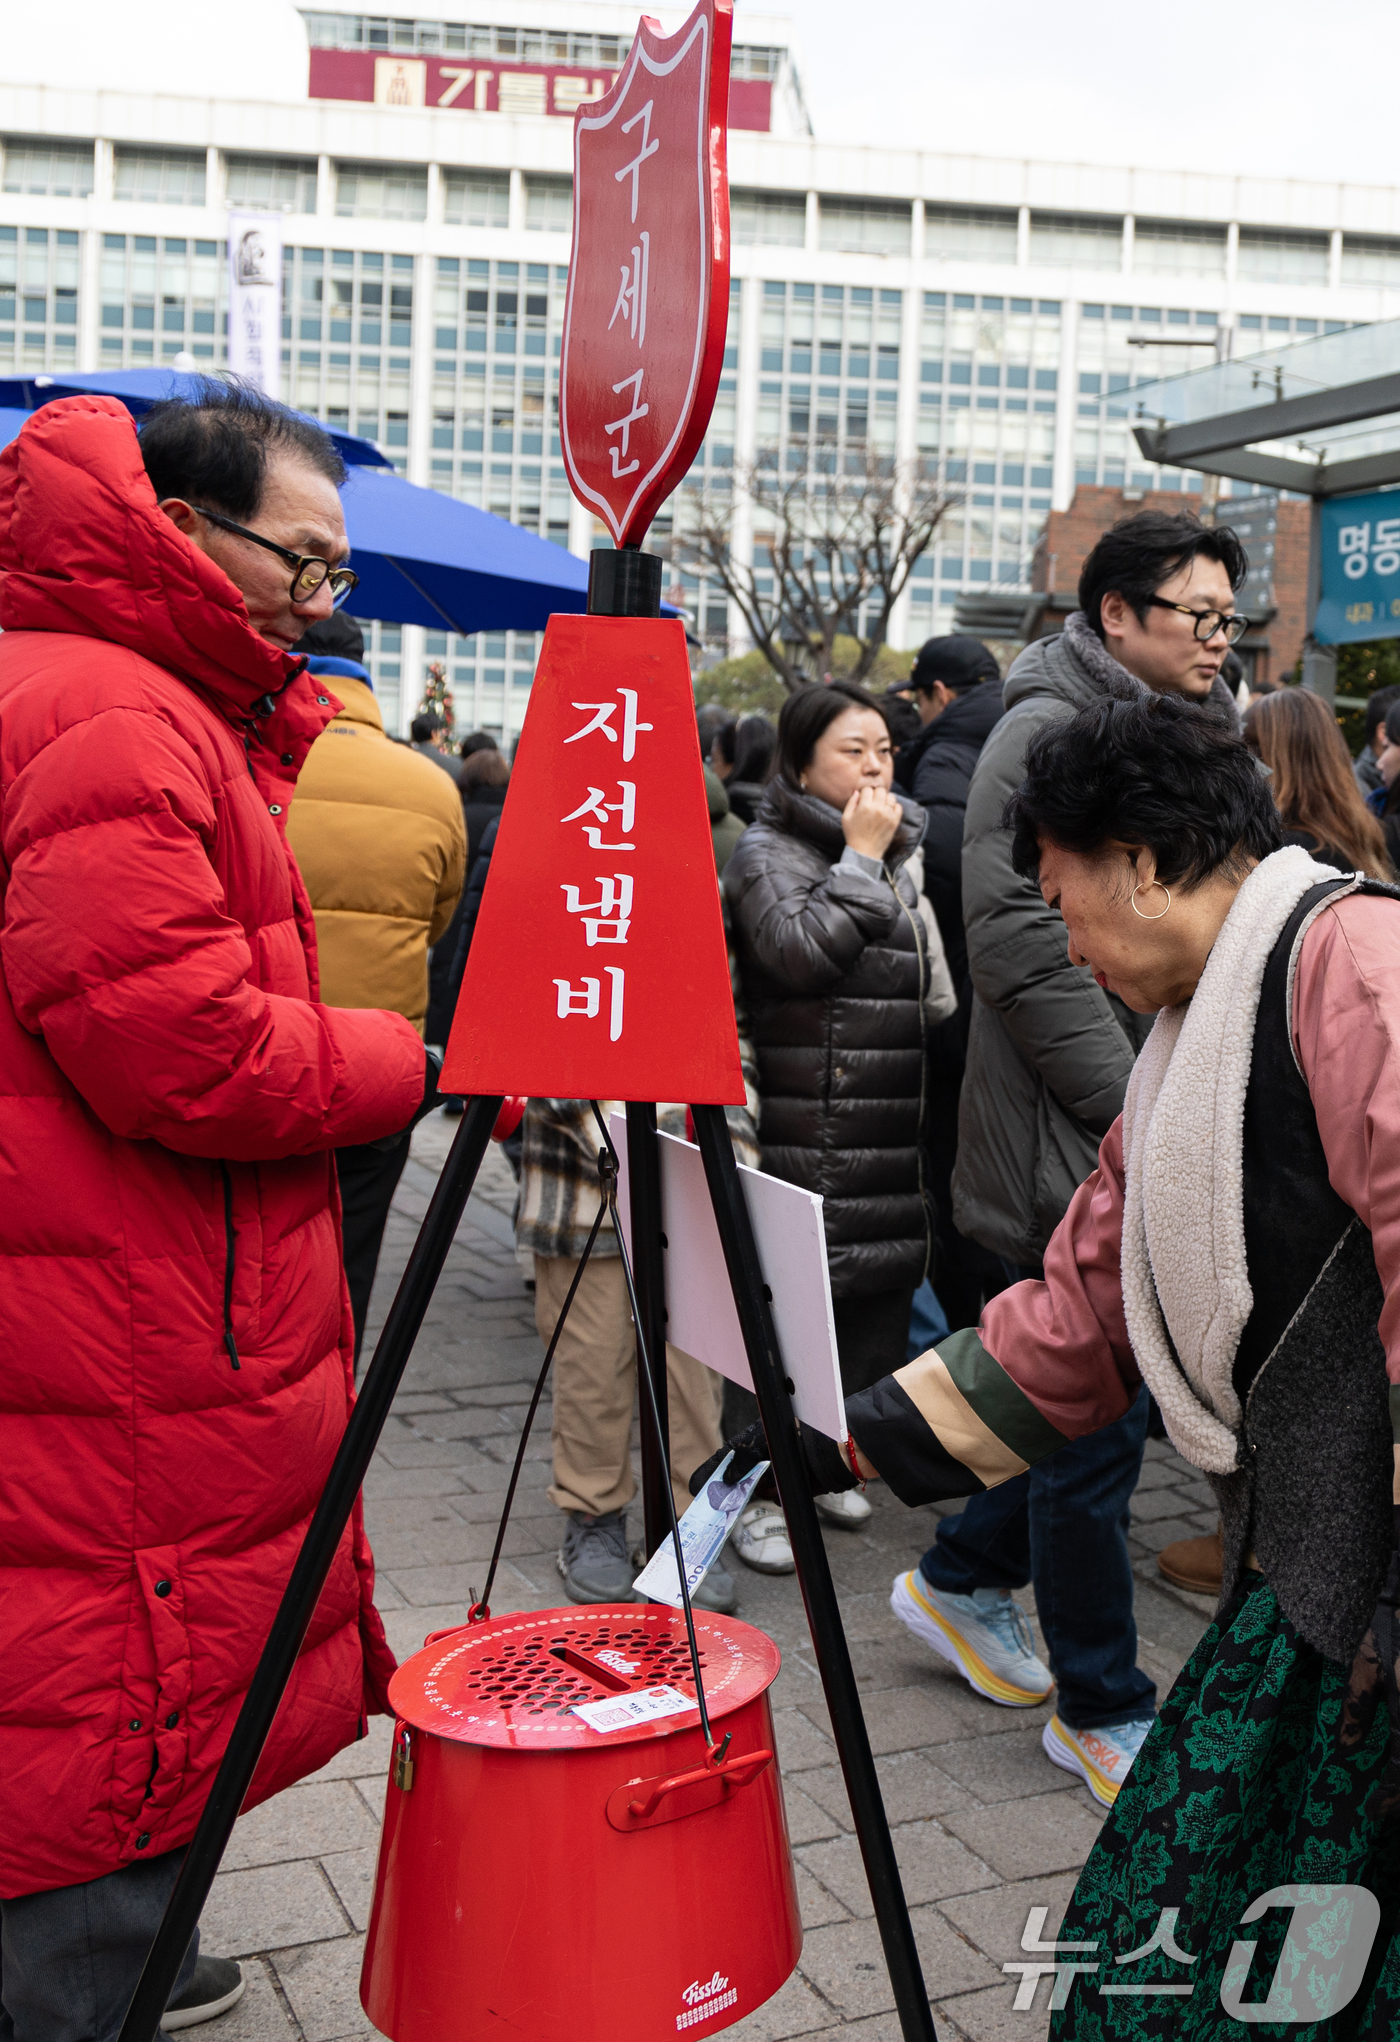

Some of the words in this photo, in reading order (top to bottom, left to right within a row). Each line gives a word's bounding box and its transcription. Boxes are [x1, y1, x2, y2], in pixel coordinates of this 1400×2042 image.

[604, 99, 660, 479] 구세군
[552, 688, 654, 1042] 자선냄비
[593, 1649, 641, 1674] Fissler
[1076, 1729, 1121, 1774] HOKA
[682, 1971, 729, 2006] Fissler
